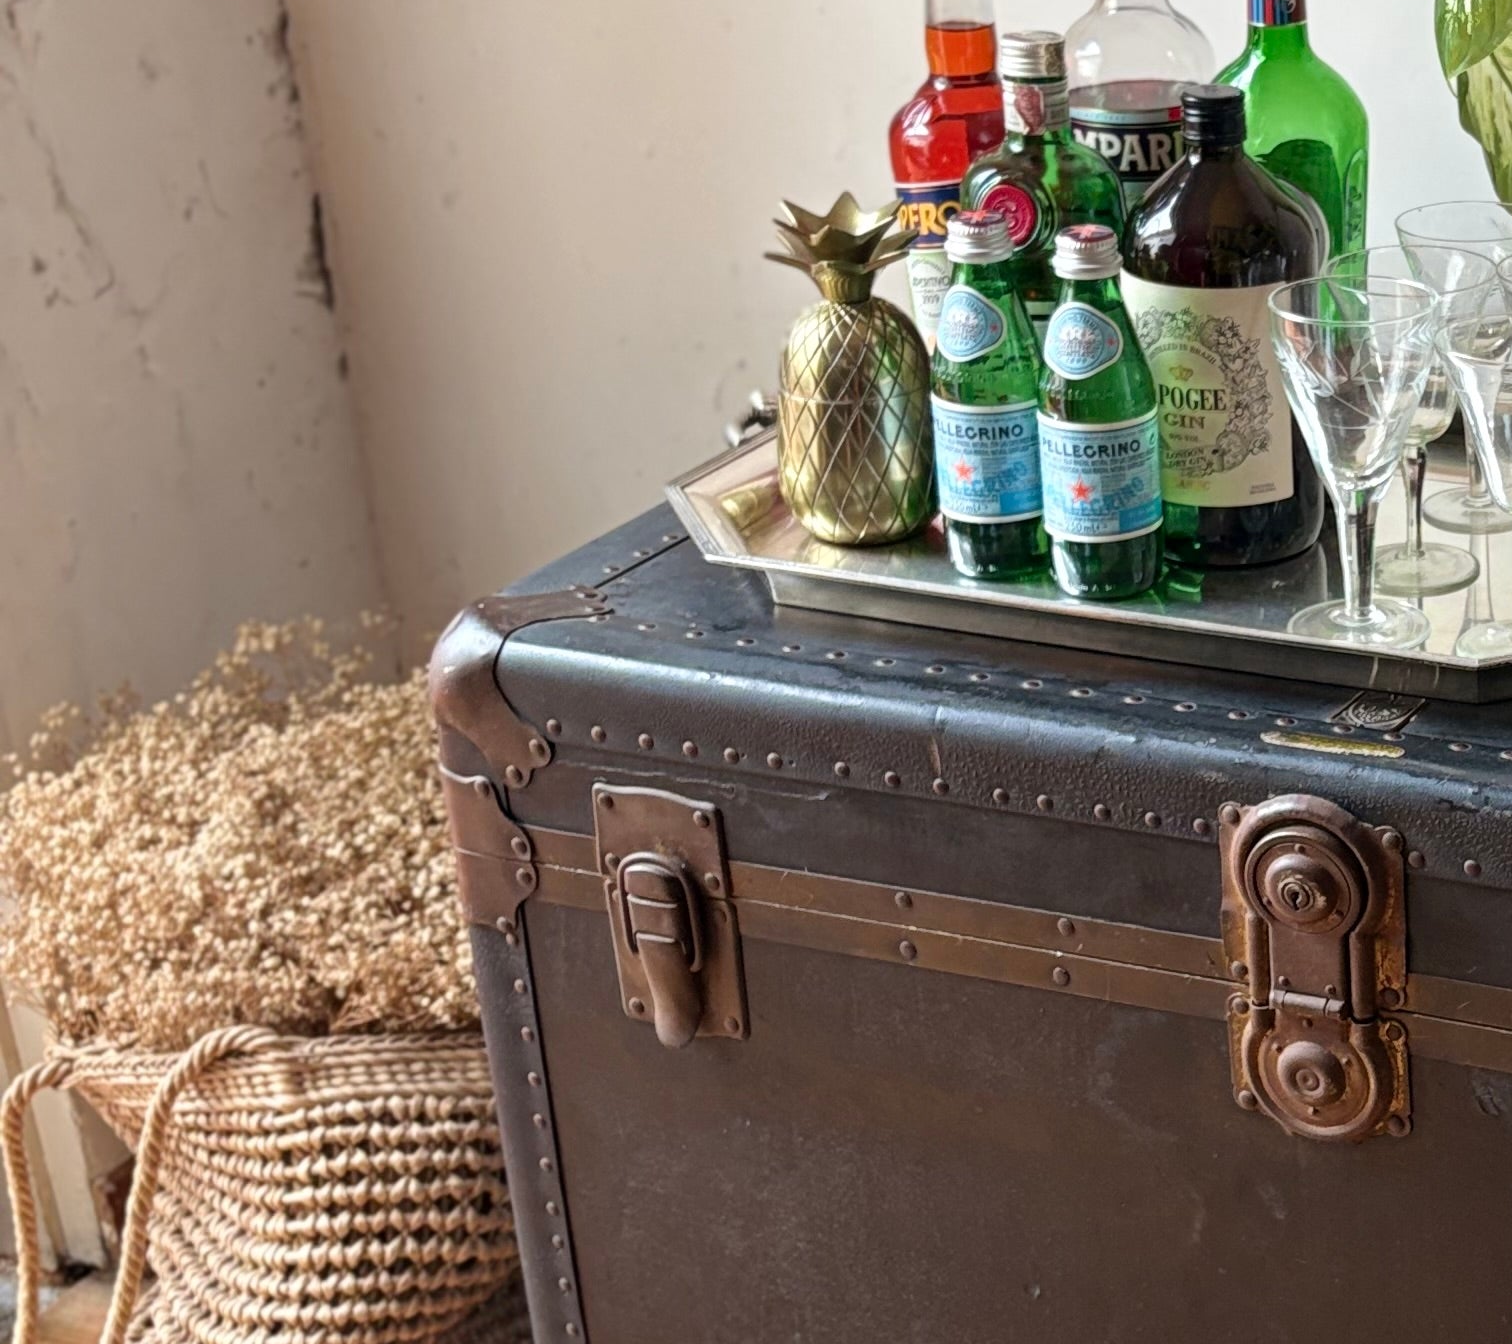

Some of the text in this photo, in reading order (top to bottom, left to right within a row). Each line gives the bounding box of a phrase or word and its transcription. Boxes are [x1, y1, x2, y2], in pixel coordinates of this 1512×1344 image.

[1158, 384, 1227, 411] POGEE
[1163, 412, 1206, 429] GIN
[1042, 437, 1141, 459] PELLEGRINO
